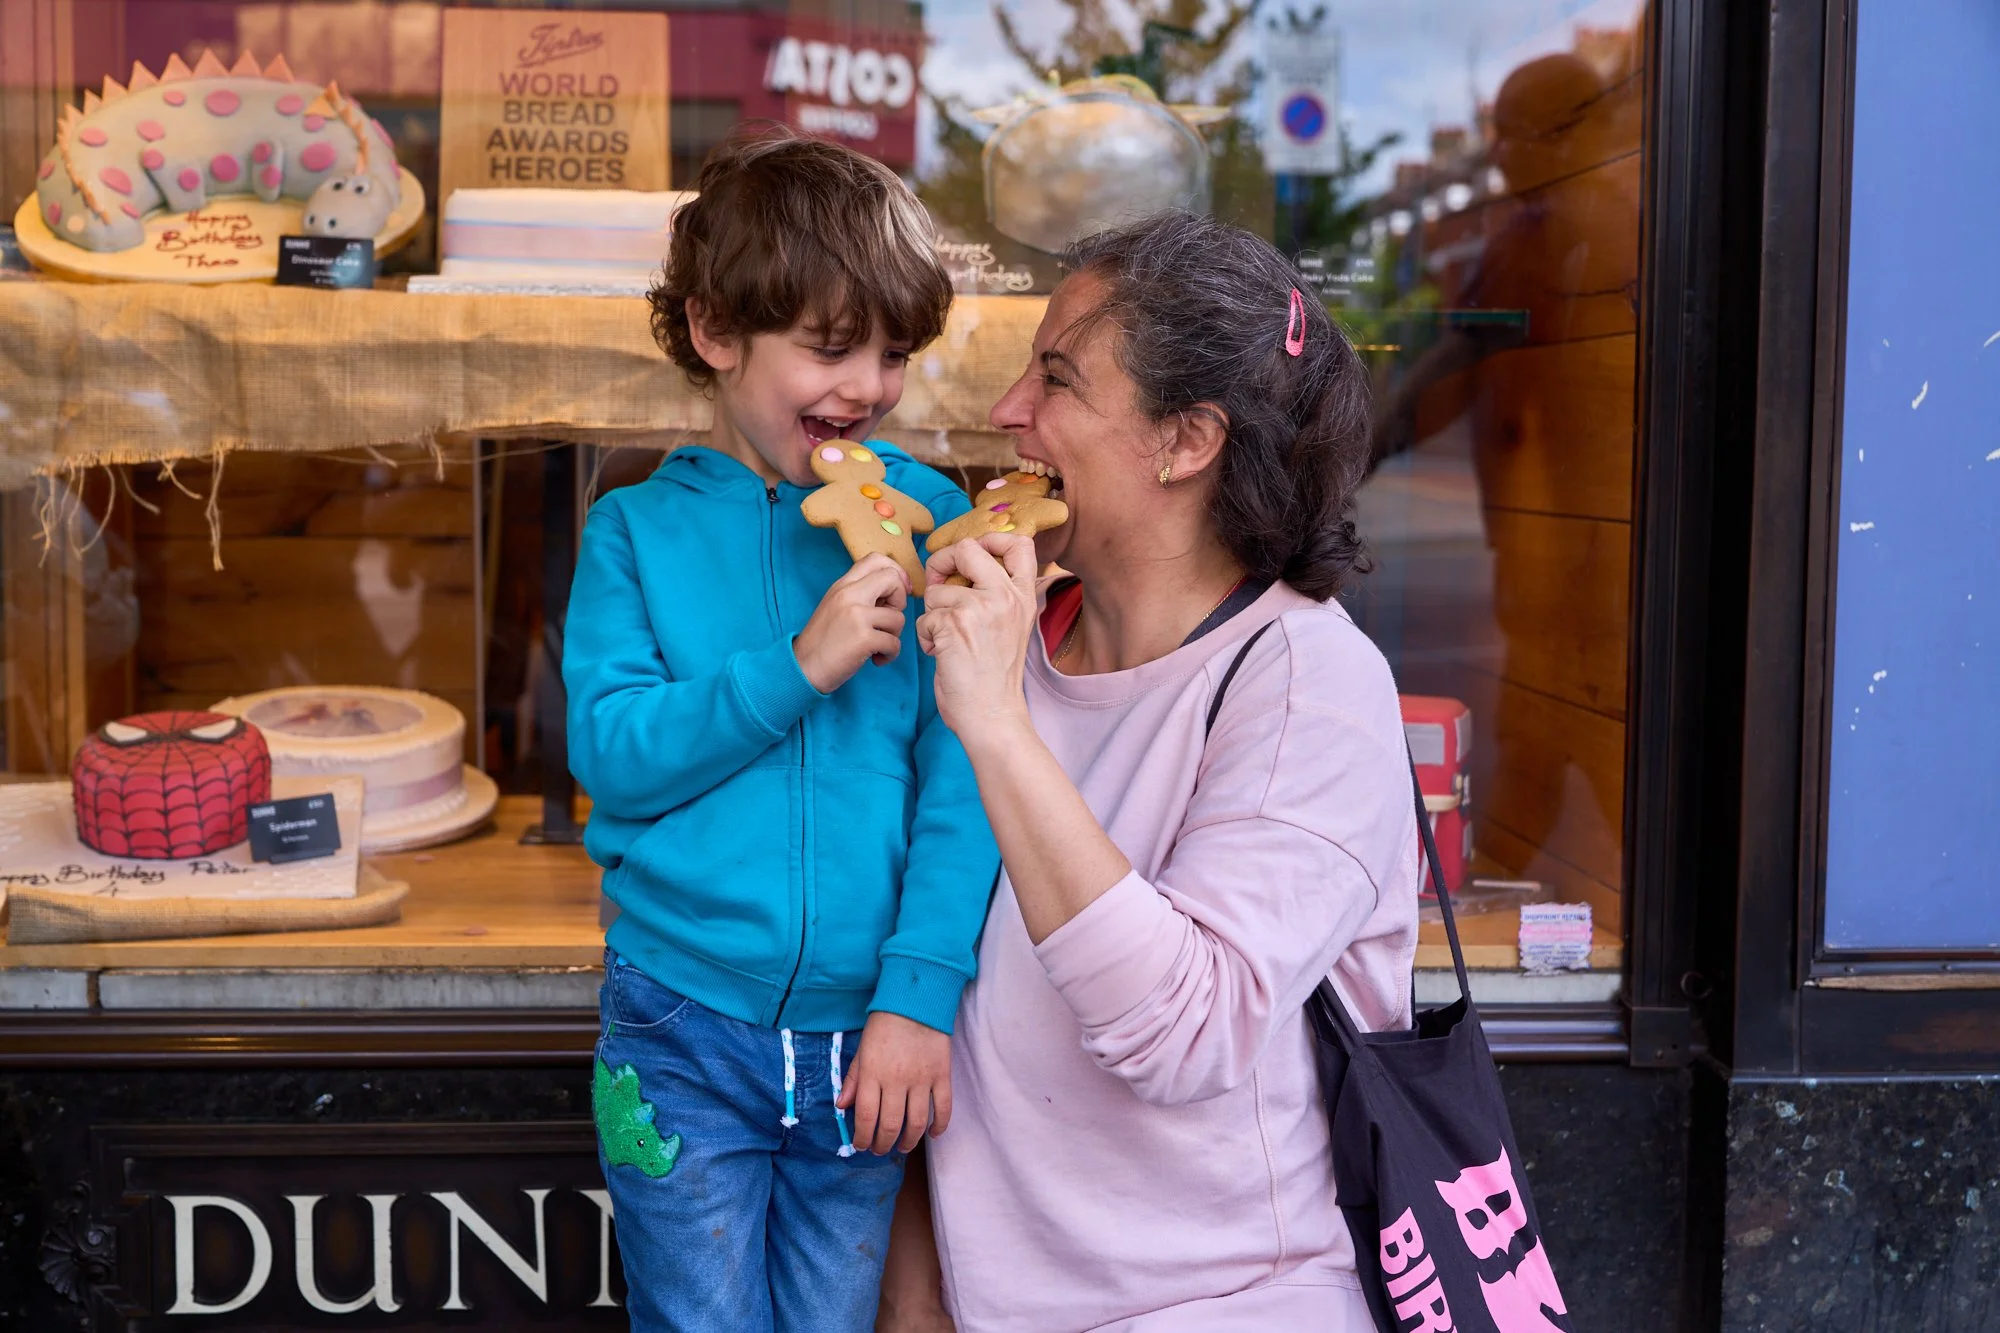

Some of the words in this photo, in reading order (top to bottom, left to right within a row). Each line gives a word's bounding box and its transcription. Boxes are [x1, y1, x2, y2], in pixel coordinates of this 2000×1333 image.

[499, 72, 619, 98] WORLD
[503, 101, 615, 125] BREAD
[486, 128, 629, 154] AWARDS
[489, 156, 624, 183] HEROES
[185, 210, 252, 230] Happy
[156, 229, 264, 252] Birthday
[291, 254, 333, 265] Dinosaur
[269, 818, 317, 834] Spiderman
[55, 864, 165, 885] Birthday
[1380, 1207, 1459, 1333] BIR
